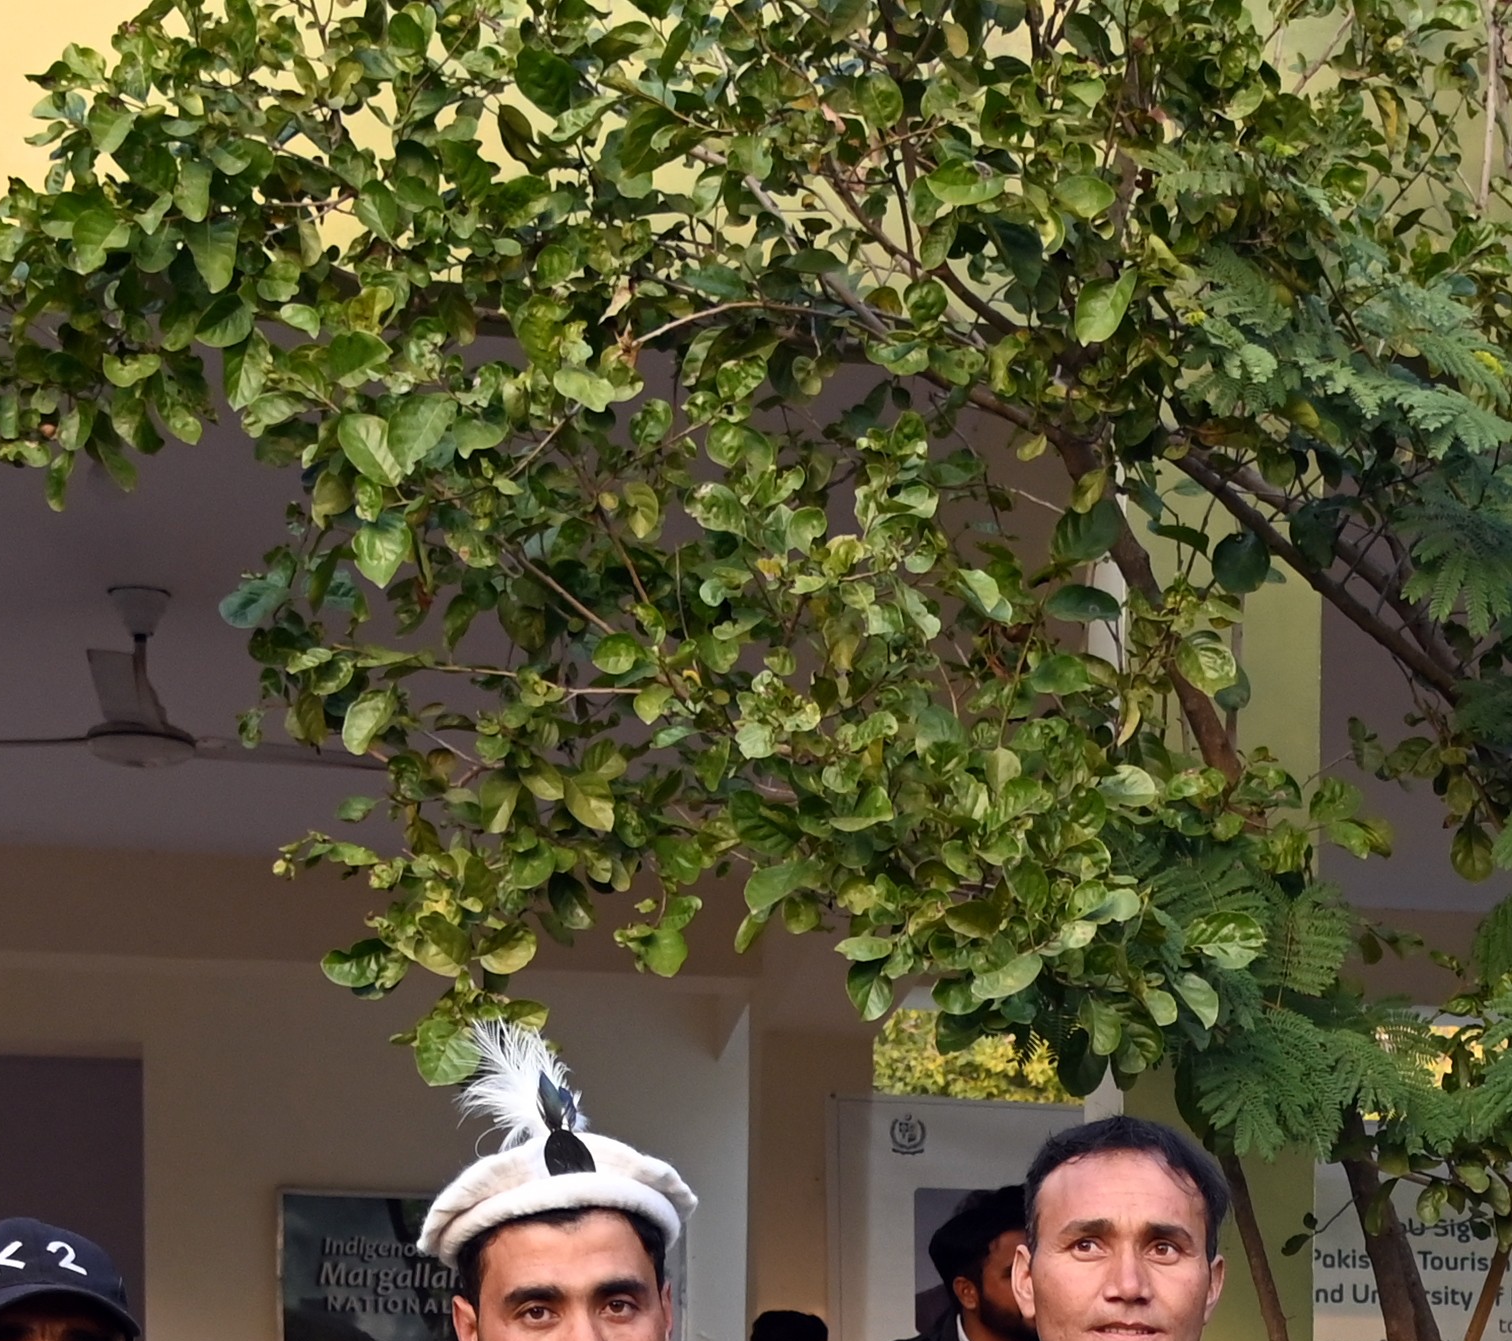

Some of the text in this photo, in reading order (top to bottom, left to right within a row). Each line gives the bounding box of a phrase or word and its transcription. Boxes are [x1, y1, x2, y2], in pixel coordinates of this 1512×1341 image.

[324, 1236, 434, 1262] Indigeno
[1418, 1250, 1510, 1272] Touris
[1313, 1284, 1344, 1304] nd
[326, 1295, 453, 1315] NATIONAL
